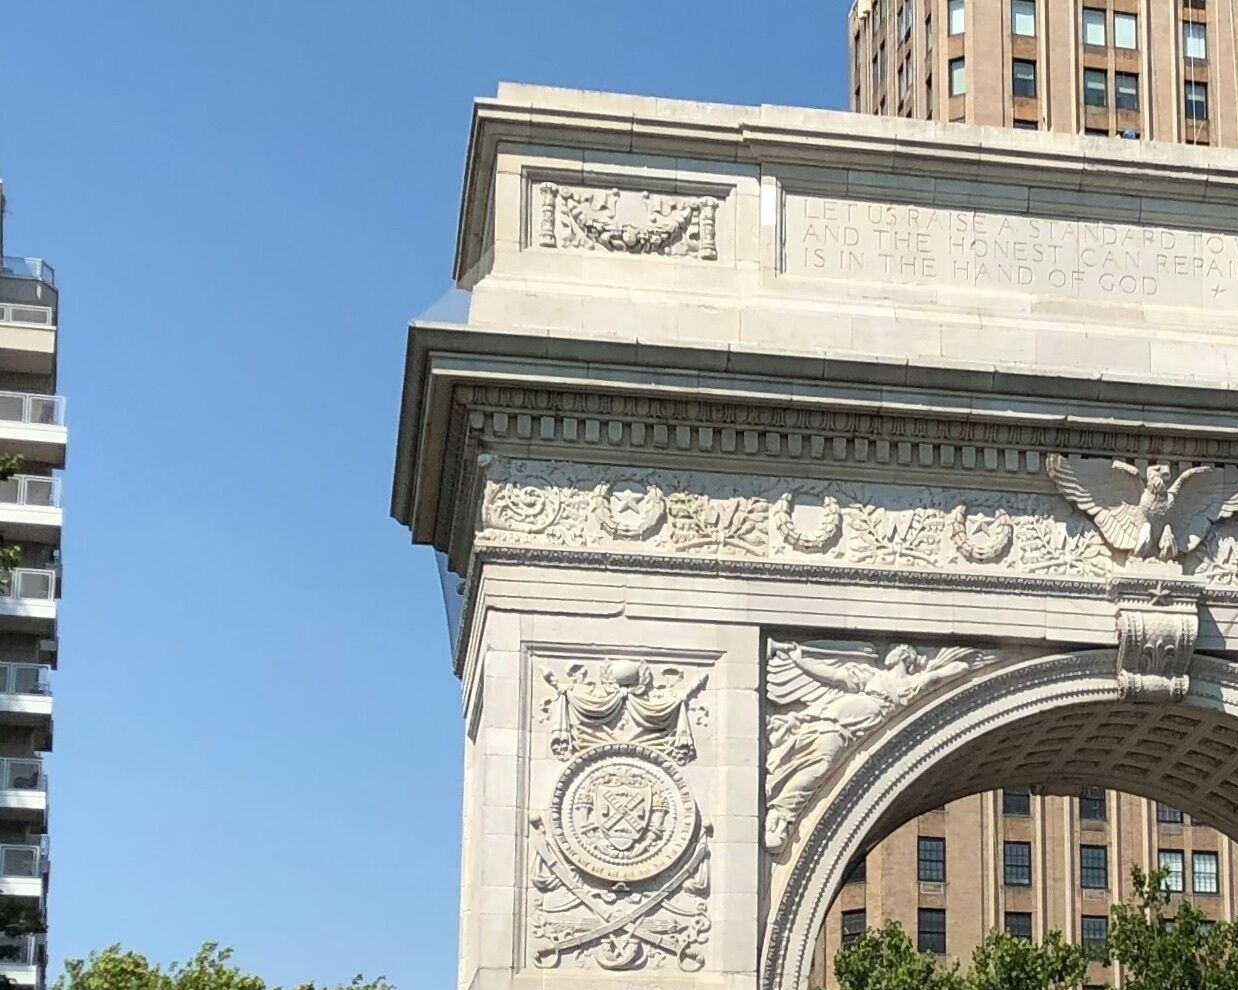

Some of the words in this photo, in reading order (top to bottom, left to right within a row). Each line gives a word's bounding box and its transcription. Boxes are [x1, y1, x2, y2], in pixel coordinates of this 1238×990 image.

[803, 223, 859, 247] AND
[872, 229, 931, 253] THE
[949, 235, 1063, 265] HONEST
[1081, 248, 1140, 270] CAN
[804, 199, 858, 223] LET
[868, 205, 897, 226] US
[908, 207, 987, 234] RAISE
[998, 217, 1015, 236] A
[1029, 219, 1176, 250] STANDARD
[1188, 233, 1224, 254] TO
[804, 247, 825, 268] IS
[840, 250, 864, 270] IN
[878, 253, 937, 278] THE
[953, 259, 1033, 285] HAND
[1049, 269, 1086, 290] OF
[1099, 272, 1158, 296] GOD
